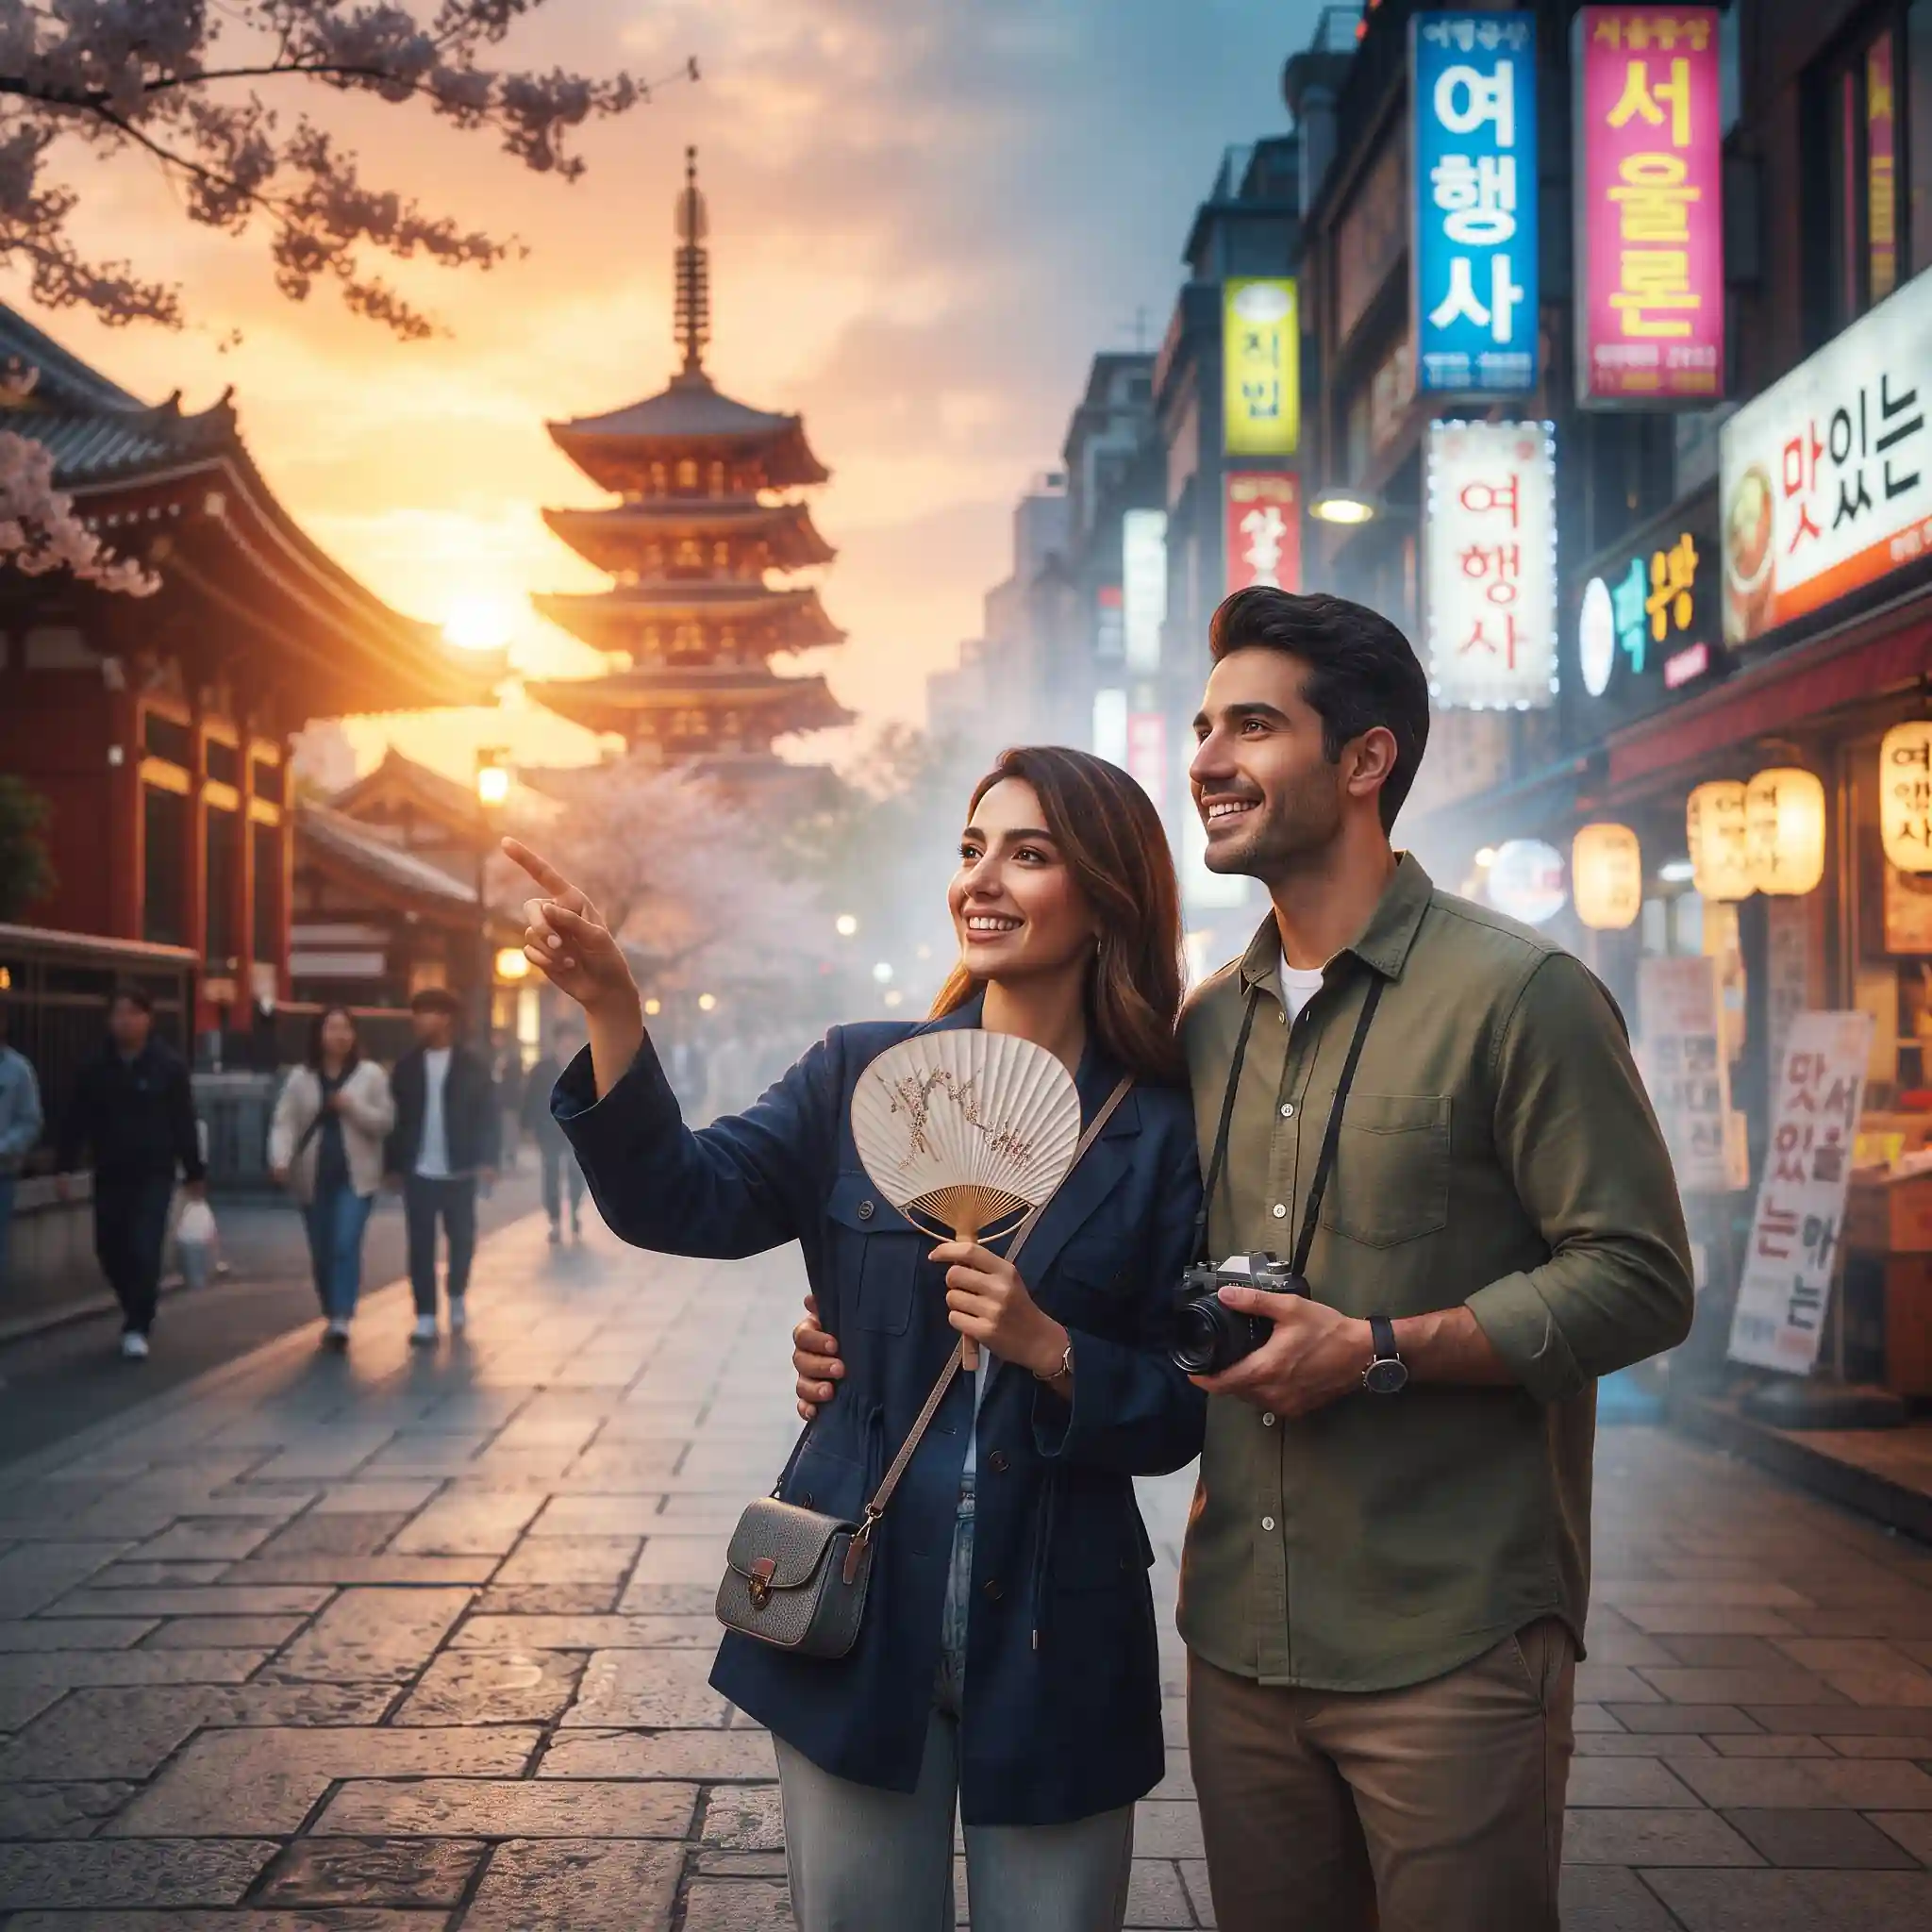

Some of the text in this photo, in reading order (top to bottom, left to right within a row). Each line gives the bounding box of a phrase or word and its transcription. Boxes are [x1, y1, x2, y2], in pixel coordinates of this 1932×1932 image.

[1428, 58, 1524, 344] 여행사
[1607, 57, 1702, 338] 서울론
[1782, 373, 1925, 555] 맛있는
[1459, 474, 1527, 671] 여행사
[1757, 1050, 1827, 1259] 맛있는
